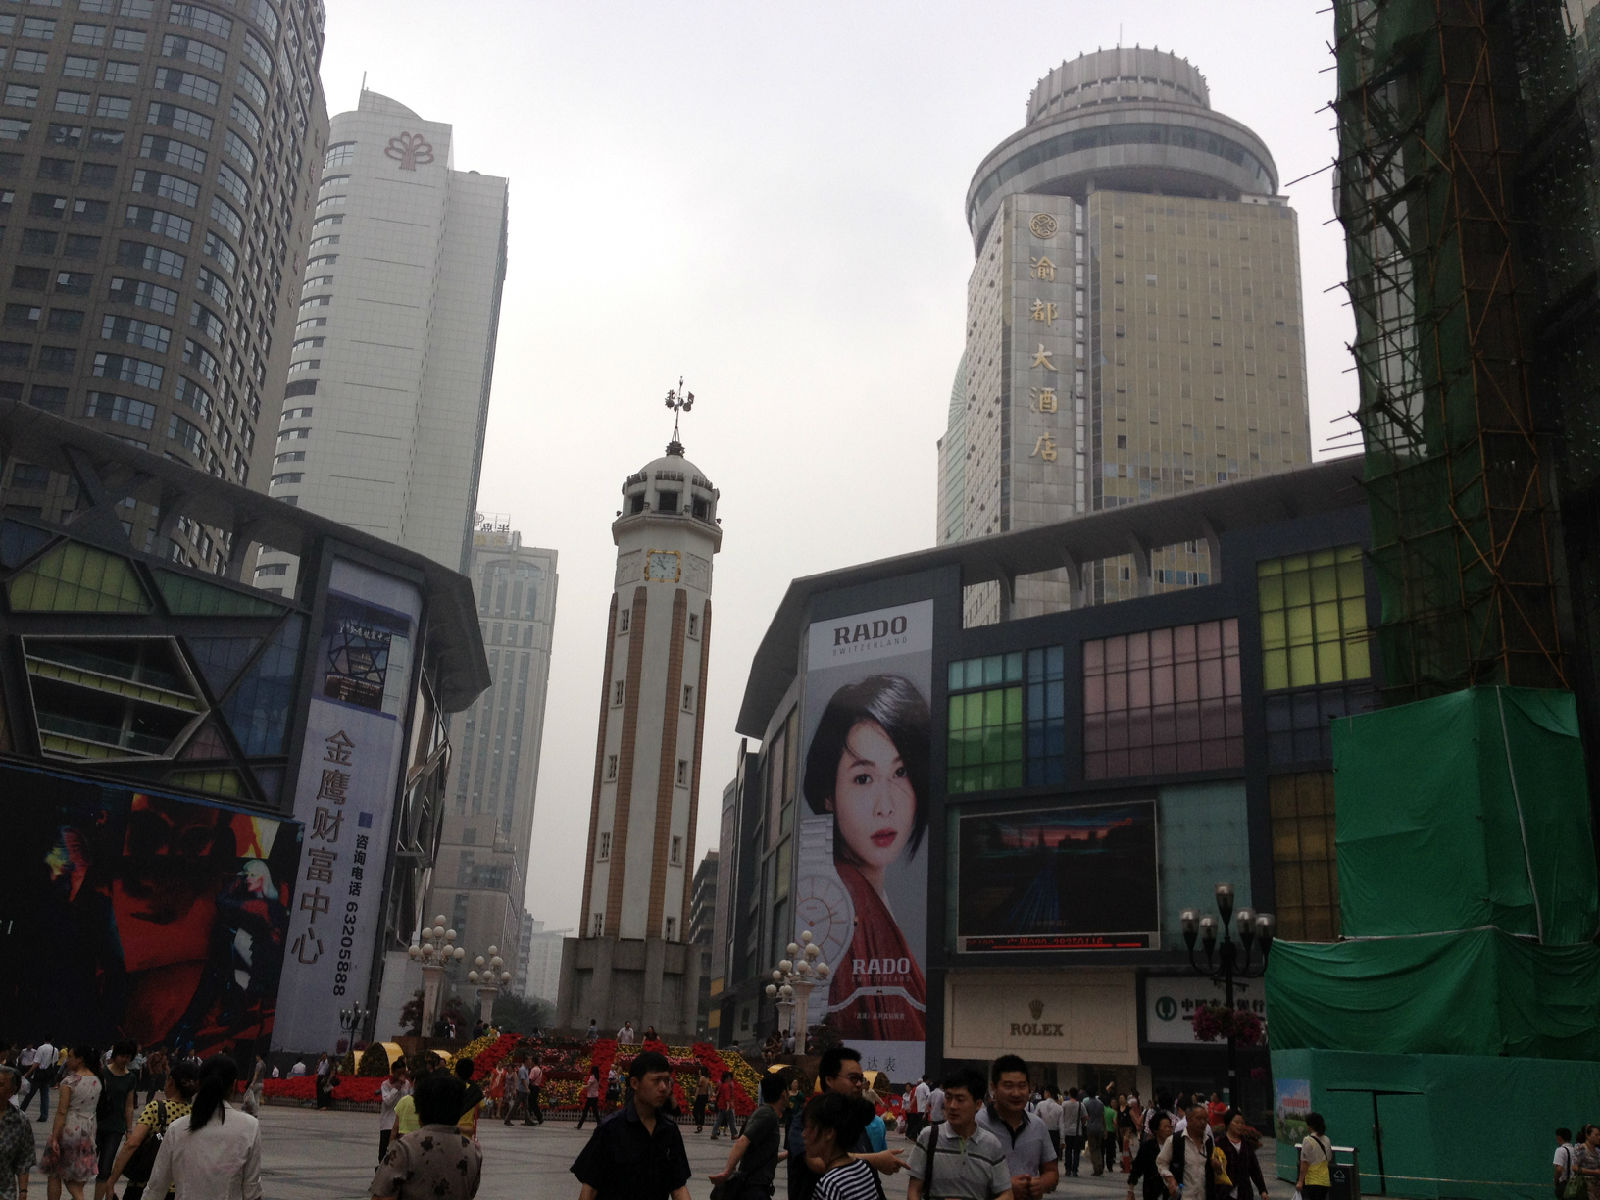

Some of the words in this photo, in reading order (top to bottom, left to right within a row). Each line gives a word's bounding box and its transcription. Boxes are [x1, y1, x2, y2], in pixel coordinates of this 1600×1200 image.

[1028, 255, 1059, 462] 渝都大酒店
[832, 615, 908, 647] RADO
[832, 635, 908, 657] SWITZERLAND
[290, 729, 356, 965] 金鹰财富中心
[348, 834, 369, 897] 咨询电话
[332, 901, 359, 997] 63205888
[851, 957, 911, 976] RADO
[1010, 1023, 1065, 1037] ROLEX
